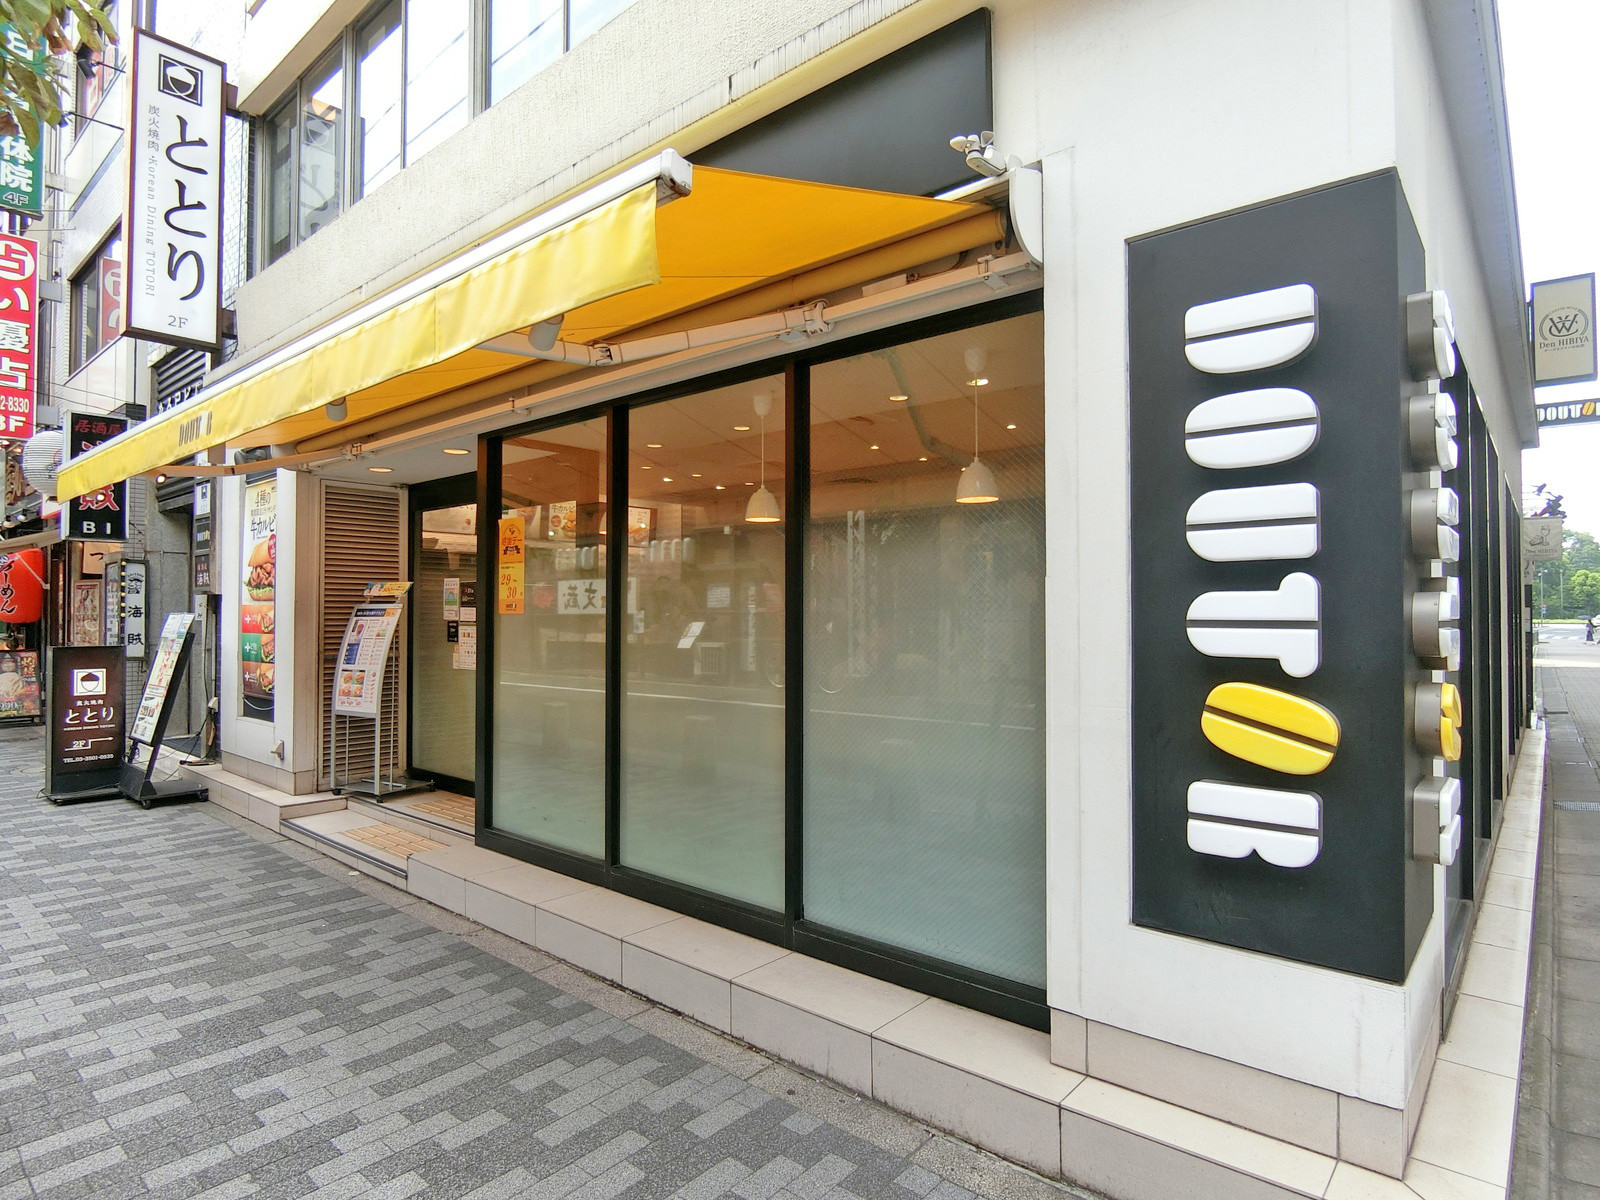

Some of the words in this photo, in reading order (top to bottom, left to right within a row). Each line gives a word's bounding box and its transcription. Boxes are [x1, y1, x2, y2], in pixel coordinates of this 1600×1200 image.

[3, 192, 28, 205] 4F
[164, 115, 208, 300] ととり
[146, 206, 157, 246] Dining
[145, 251, 155, 297] TOTORI
[167, 315, 189, 329] 2F
[1540, 342, 1555, 350] Den
[1559, 336, 1589, 348] HIBIYA
[74, 419, 122, 435] 居酒屋
[1185, 283, 1341, 869] DOUTOR
[127, 604, 145, 647] 海賊
[65, 707, 114, 724] ととり
[72, 740, 86, 748] 2F
